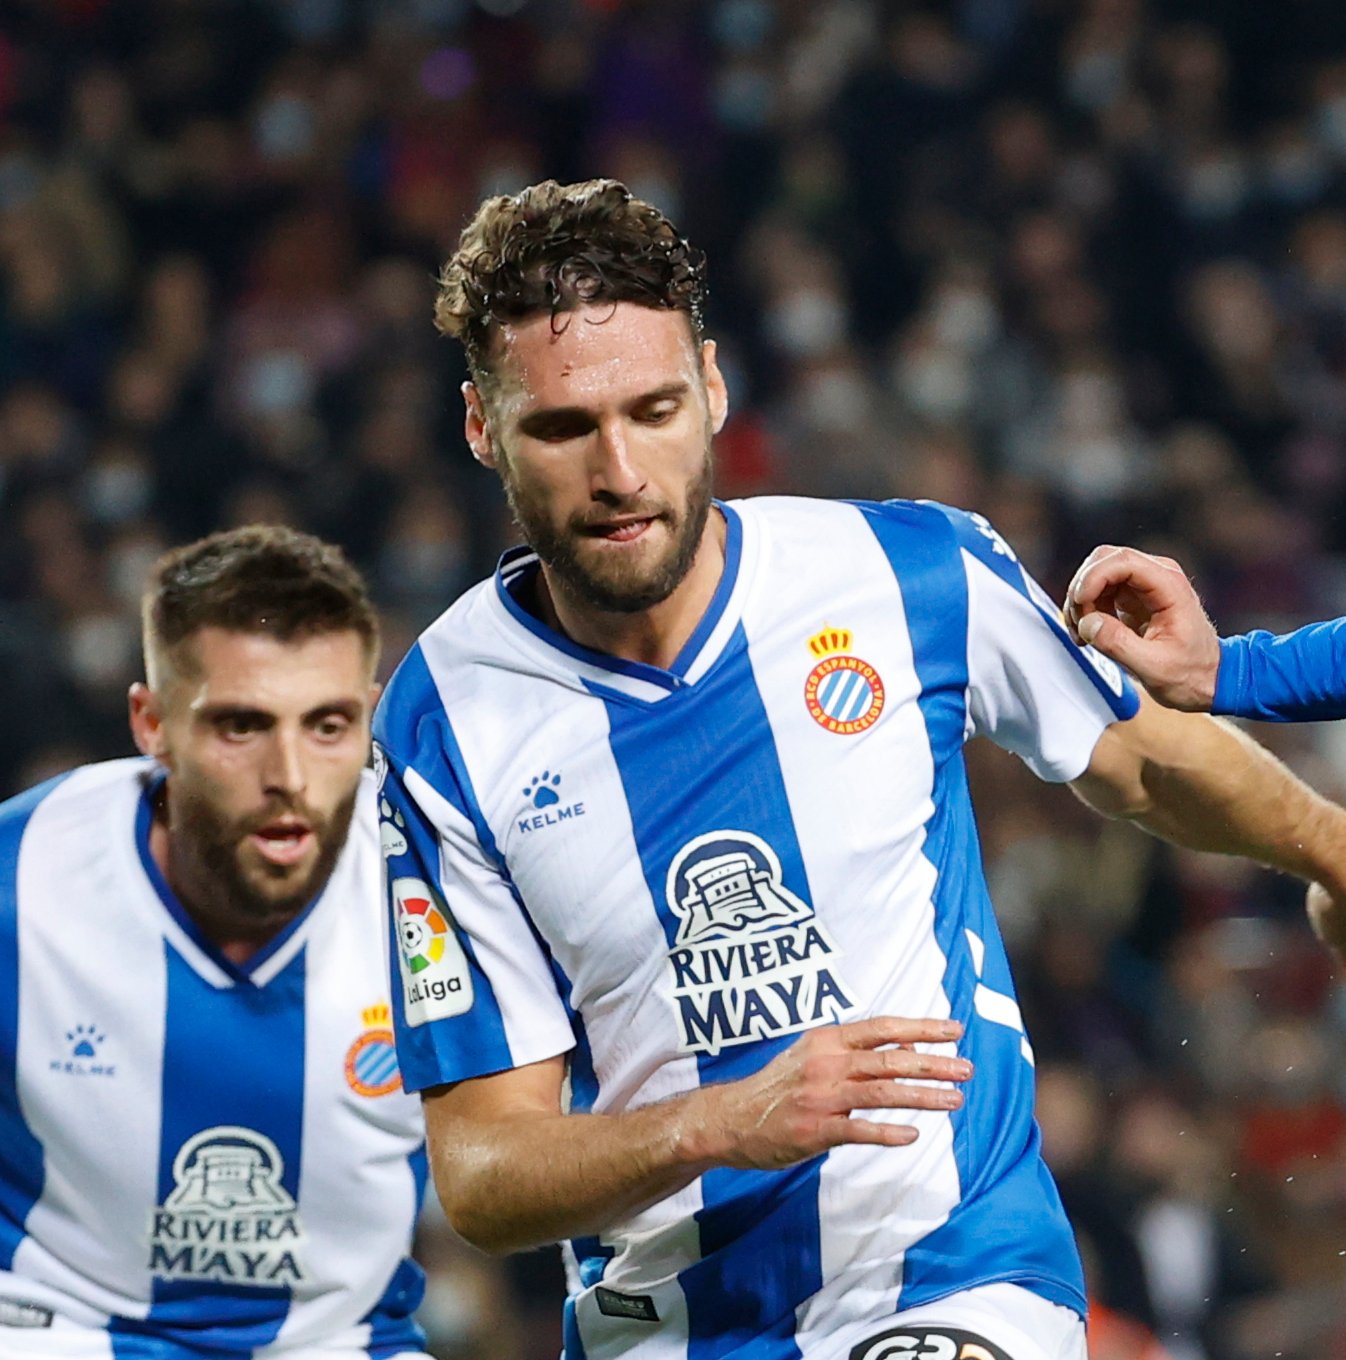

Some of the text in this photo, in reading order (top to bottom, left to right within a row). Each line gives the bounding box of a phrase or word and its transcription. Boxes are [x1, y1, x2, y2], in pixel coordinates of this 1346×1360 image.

[806, 658, 877, 699] RCD ESPANYOL
[811, 689, 883, 732] DE BARCELONA
[518, 802, 585, 833] KELME
[668, 926, 833, 988] RIVIERA
[674, 968, 854, 1047] MAYA
[152, 1213, 300, 1242] RIVIERA
[149, 1243, 303, 1280] MAYA
